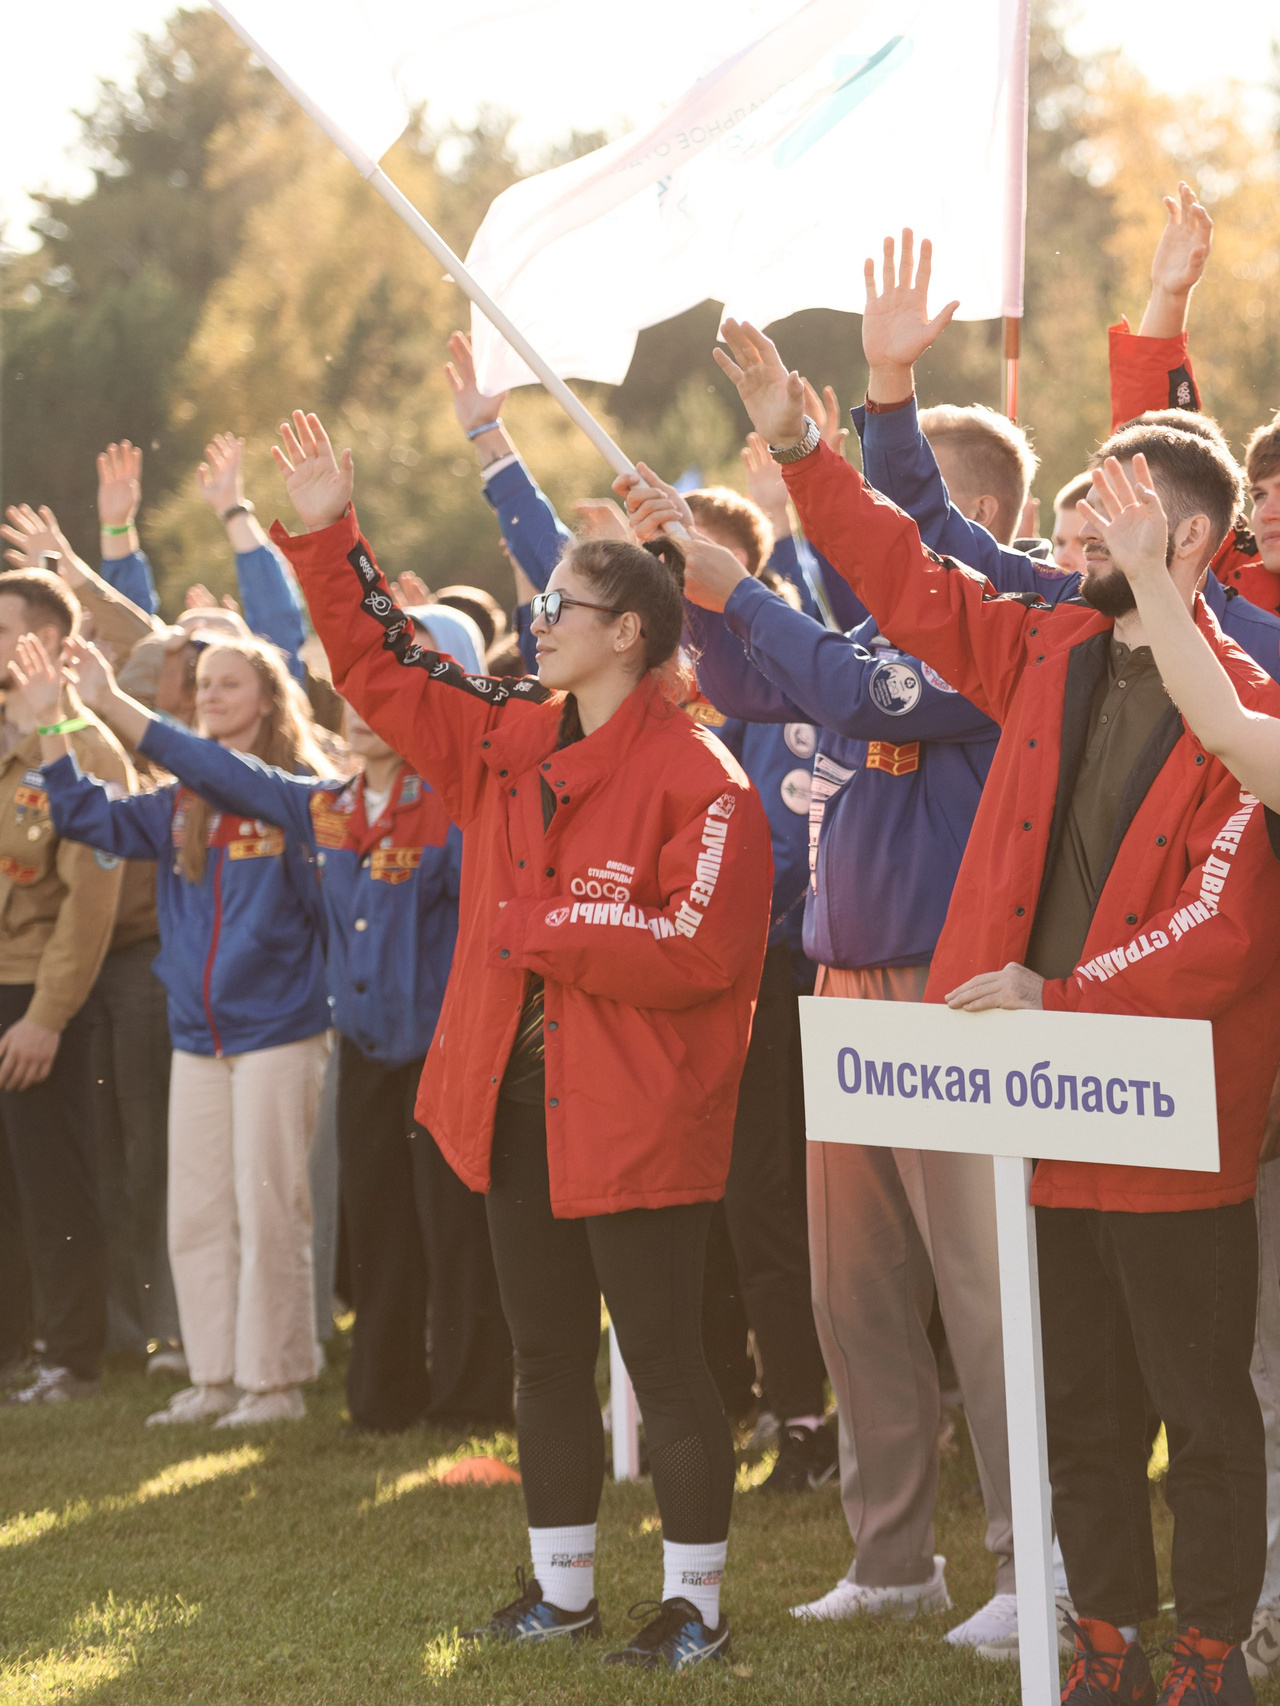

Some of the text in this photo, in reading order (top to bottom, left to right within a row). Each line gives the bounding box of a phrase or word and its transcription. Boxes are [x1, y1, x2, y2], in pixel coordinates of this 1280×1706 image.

[1211, 785, 1260, 856] УЧШЕЕ
[570, 877, 630, 903] ООСО
[690, 817, 728, 907] ЛУЧШЕЕ
[569, 902, 649, 930] ТРАНЫ
[837, 1046, 1175, 1118] Омская область
